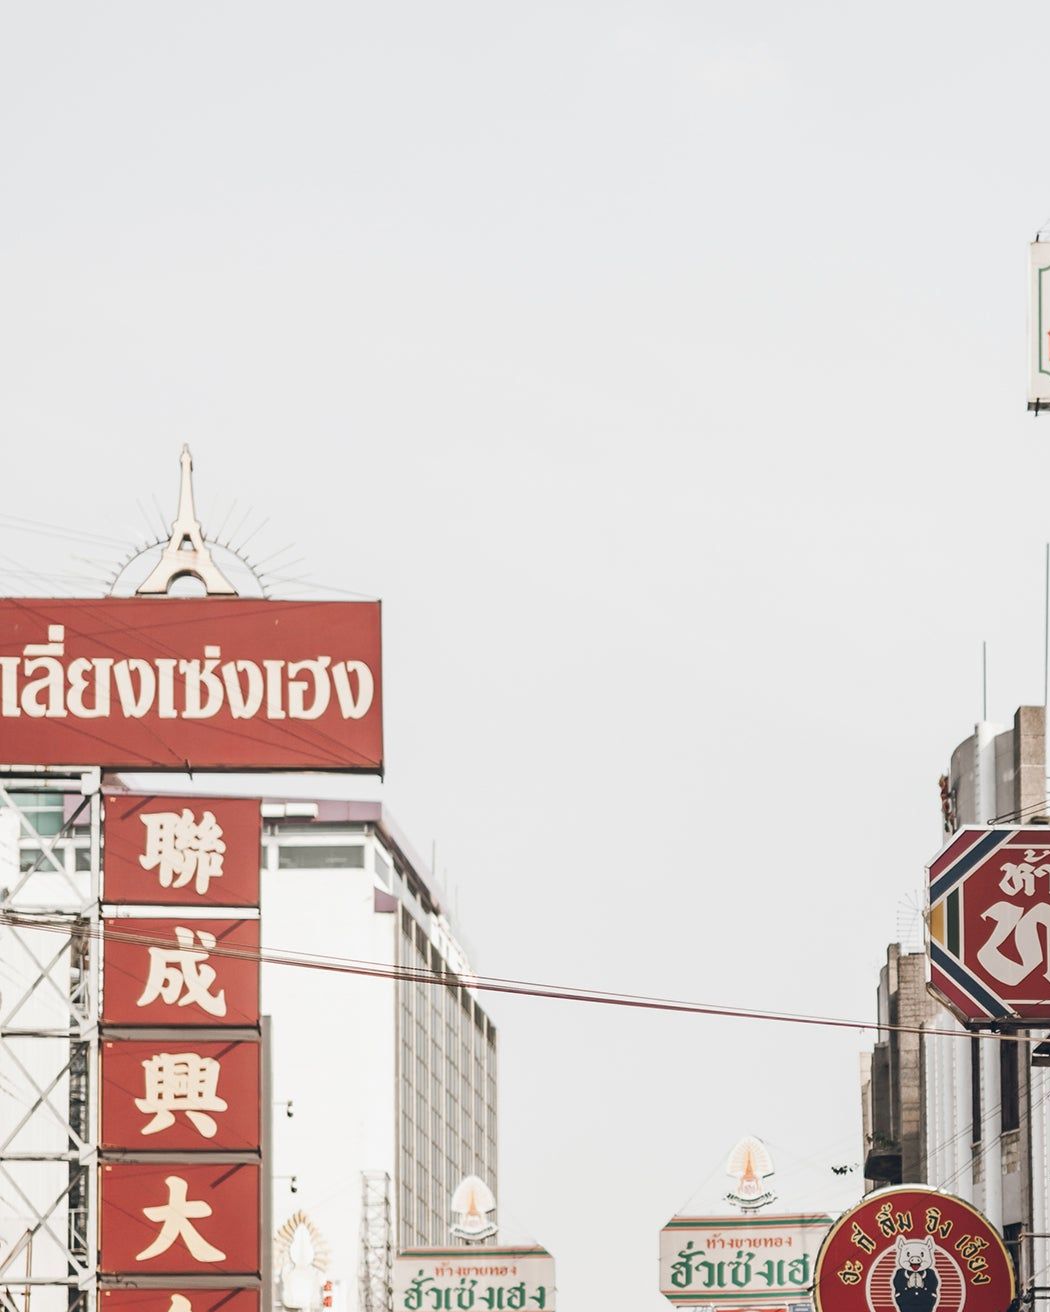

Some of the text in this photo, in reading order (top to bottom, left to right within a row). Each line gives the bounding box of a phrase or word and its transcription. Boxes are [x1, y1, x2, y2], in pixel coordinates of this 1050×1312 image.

[403, 1269, 547, 1311] ฮั่วเซ่งเฮง
